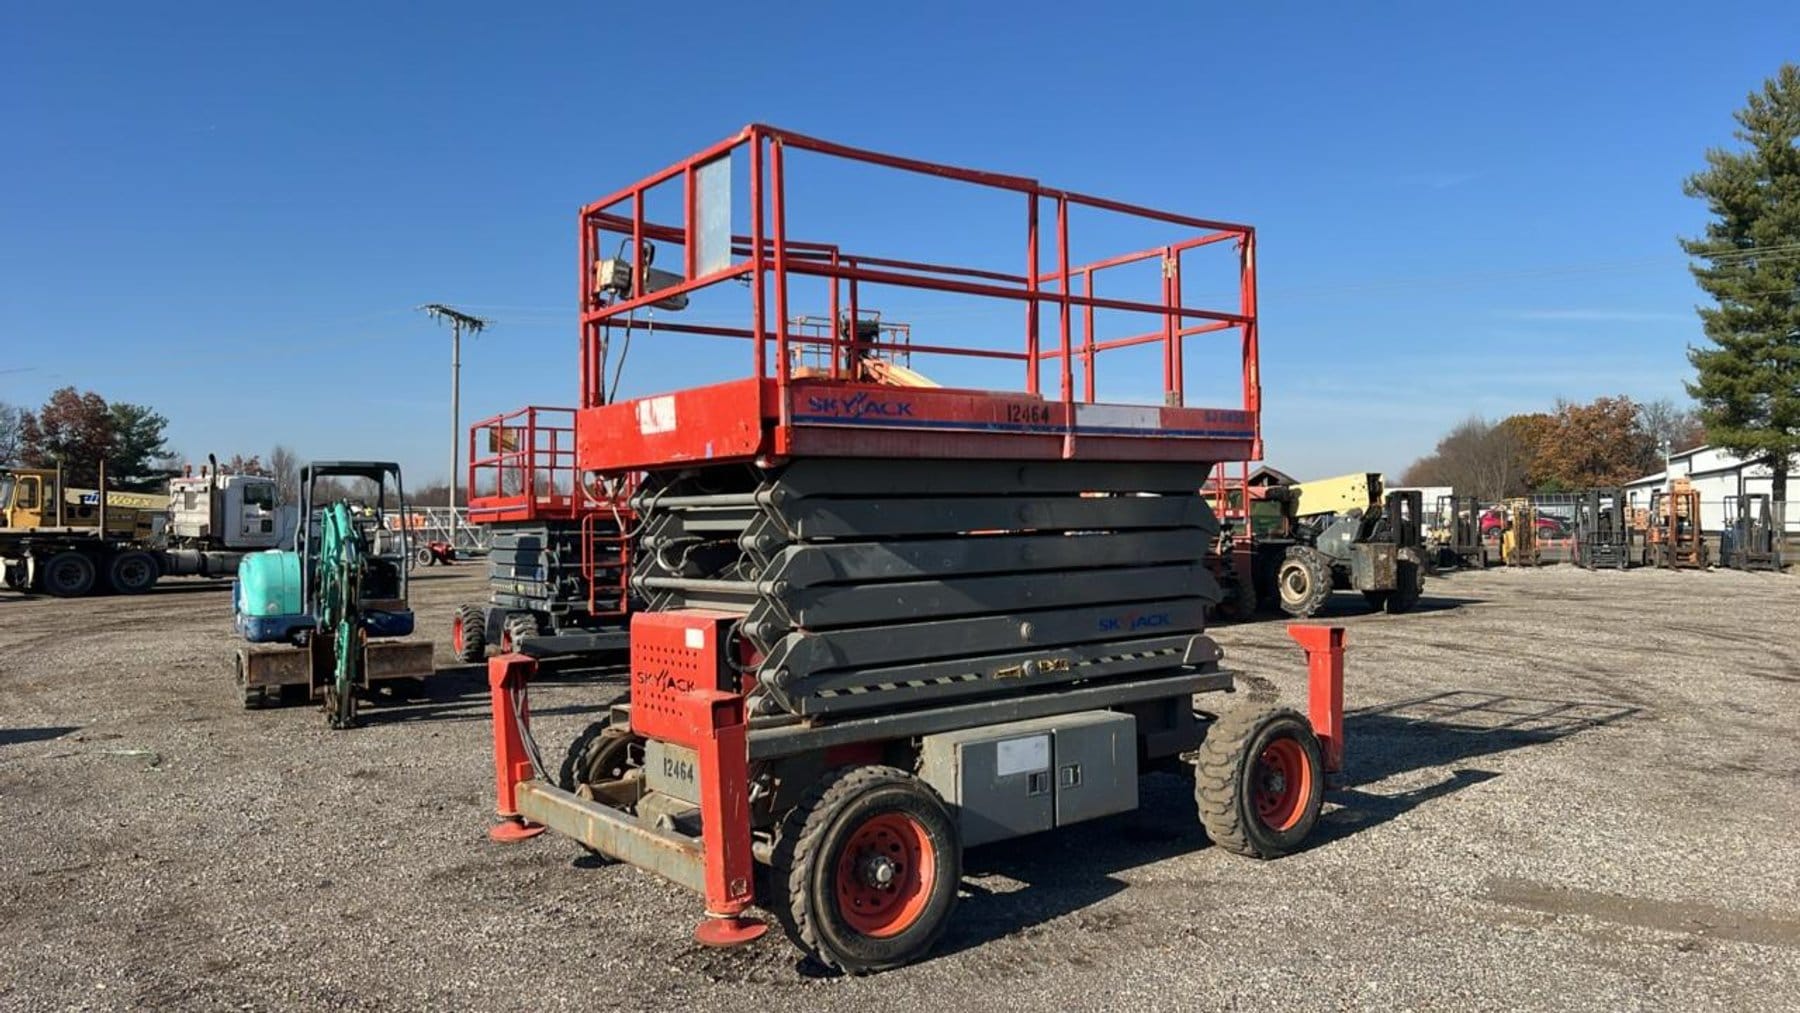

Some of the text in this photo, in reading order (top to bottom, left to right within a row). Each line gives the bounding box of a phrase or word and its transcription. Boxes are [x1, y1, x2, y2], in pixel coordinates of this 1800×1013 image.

[808, 391, 913, 417] SKYJACK
[1007, 404, 1050, 424] 12464
[637, 669, 697, 693] SKYJACK
[663, 757, 694, 784] 12464
